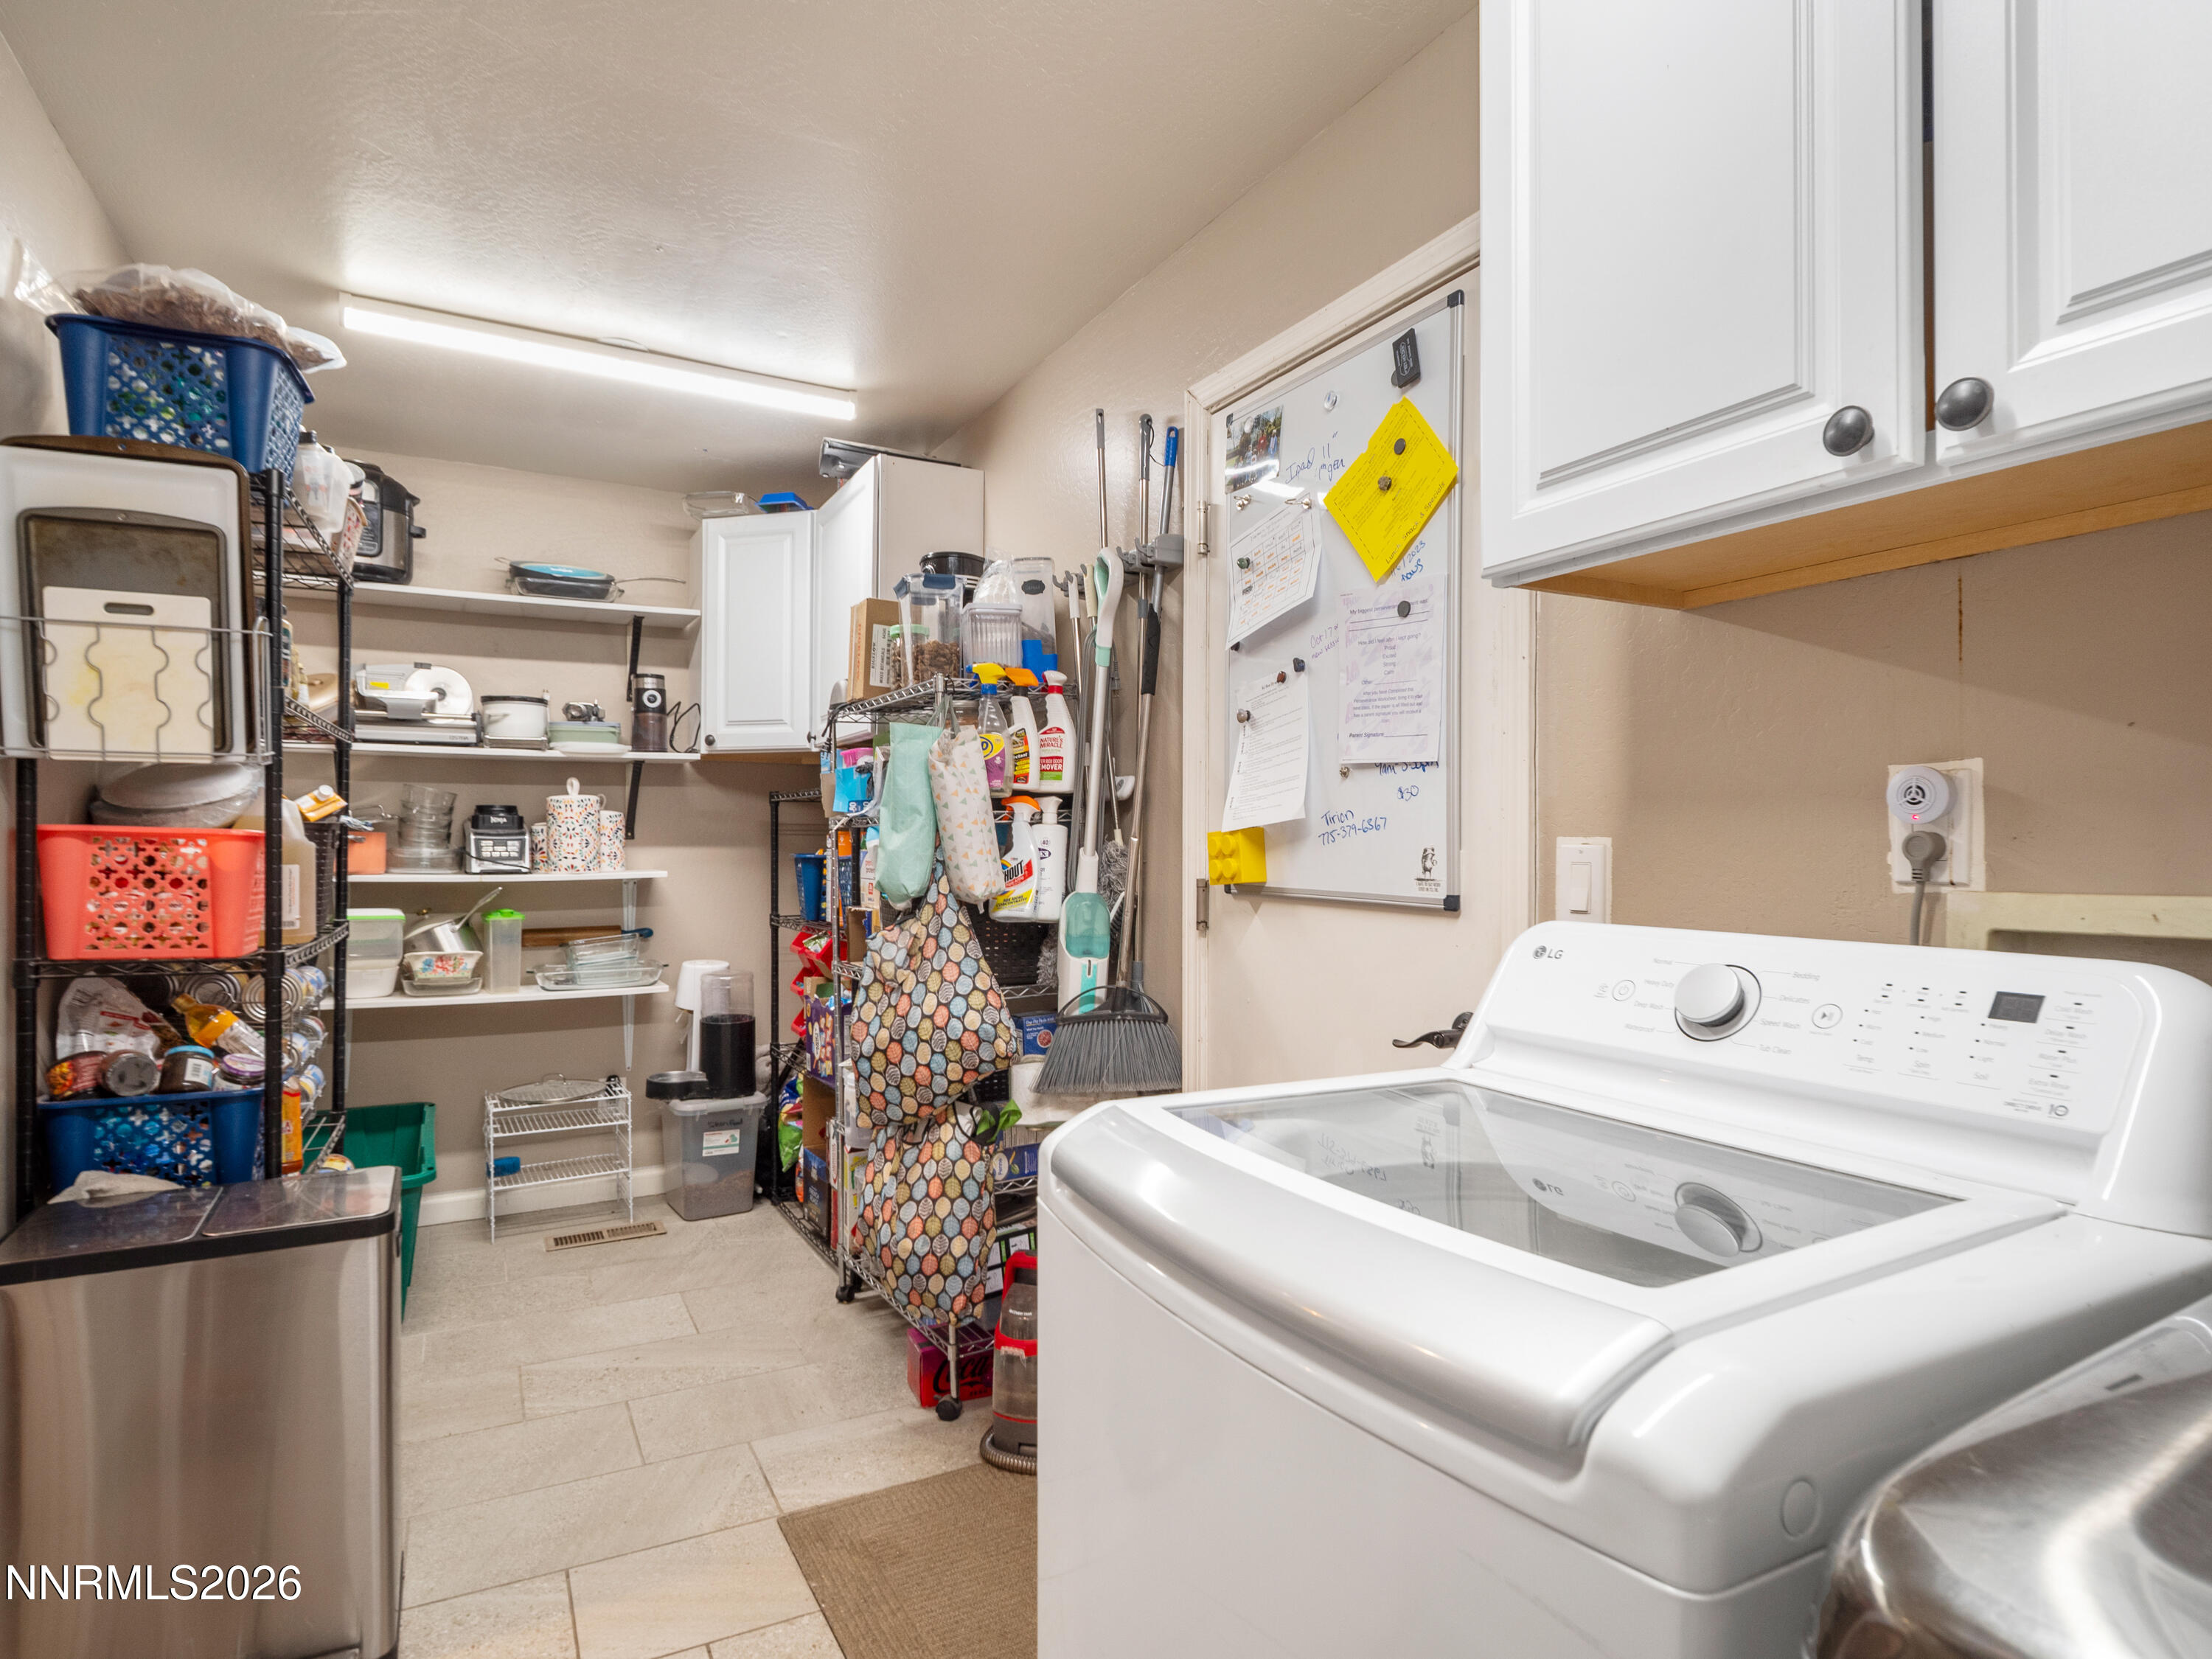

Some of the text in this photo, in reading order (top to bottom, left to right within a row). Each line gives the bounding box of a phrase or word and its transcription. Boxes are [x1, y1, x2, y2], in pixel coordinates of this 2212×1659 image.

[1386, 544, 1401, 565] Lunch
[1402, 521, 1419, 540] Snack
[1424, 482, 1445, 510] Specials
[1003, 860, 1023, 883] HOUT
[1547, 949, 1564, 959] LG
